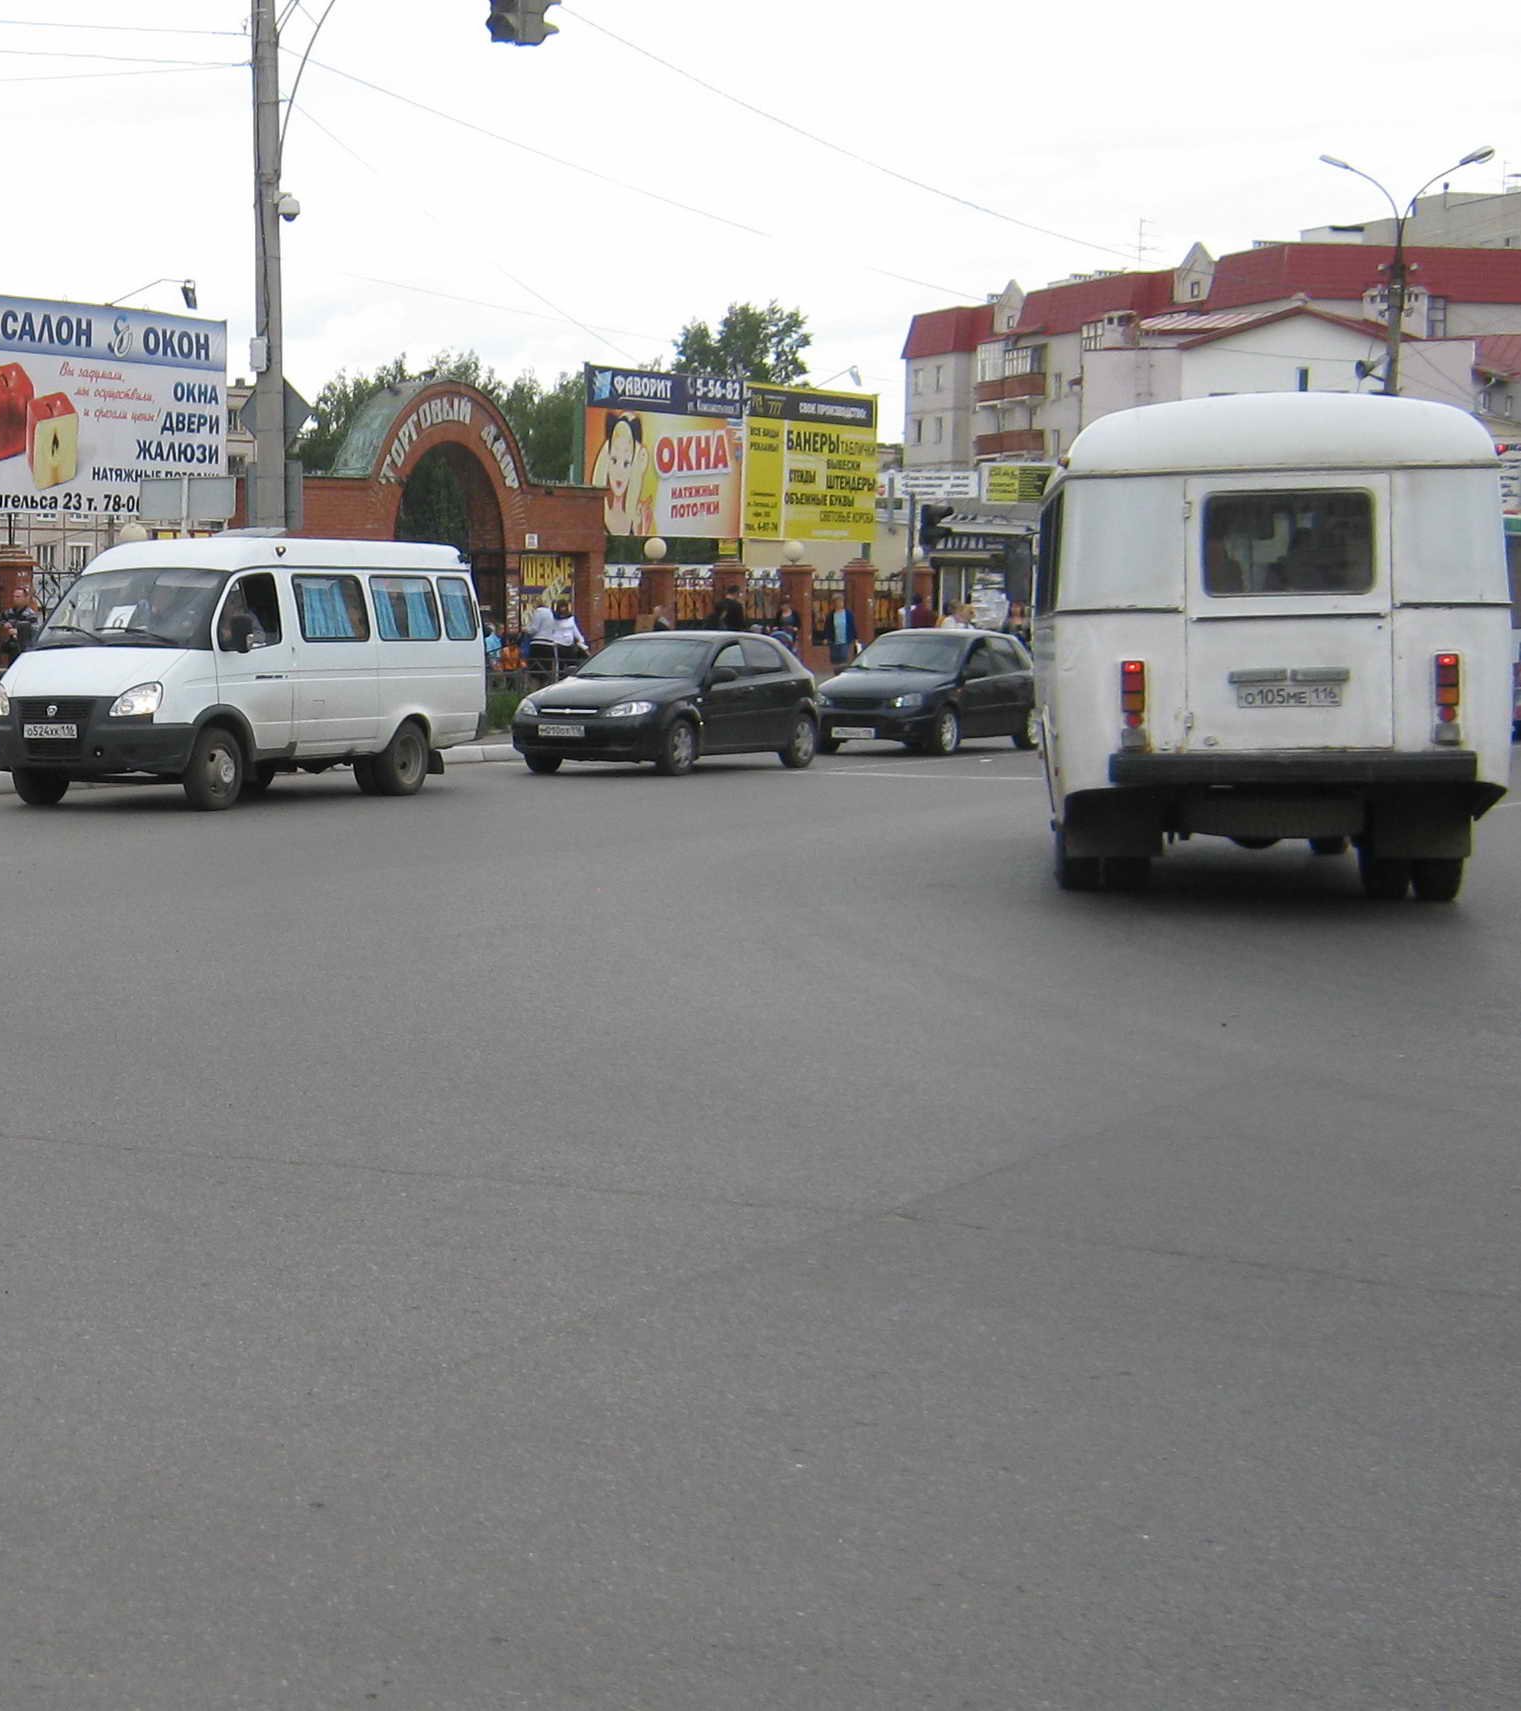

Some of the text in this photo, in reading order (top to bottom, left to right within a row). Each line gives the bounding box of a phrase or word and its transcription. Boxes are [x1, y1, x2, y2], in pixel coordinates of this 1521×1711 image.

[0, 310, 210, 361] САЛОН ОКОН
[59, 361, 74, 377] Вы
[173, 382, 219, 406] ОКНА
[613, 375, 672, 398] ФАВОРИТ
[696, 378, 740, 401] 5-56-82
[160, 411, 219, 436] ДВЕРИ
[136, 439, 219, 465] ЖАЛЮЗИ
[378, 396, 473, 486] ТОРГОВЫЙ
[786, 430, 840, 454] БАНЕРЫ
[656, 434, 729, 475] ОКНА
[63, 493, 82, 511] 23
[86, 496, 98, 512] т.
